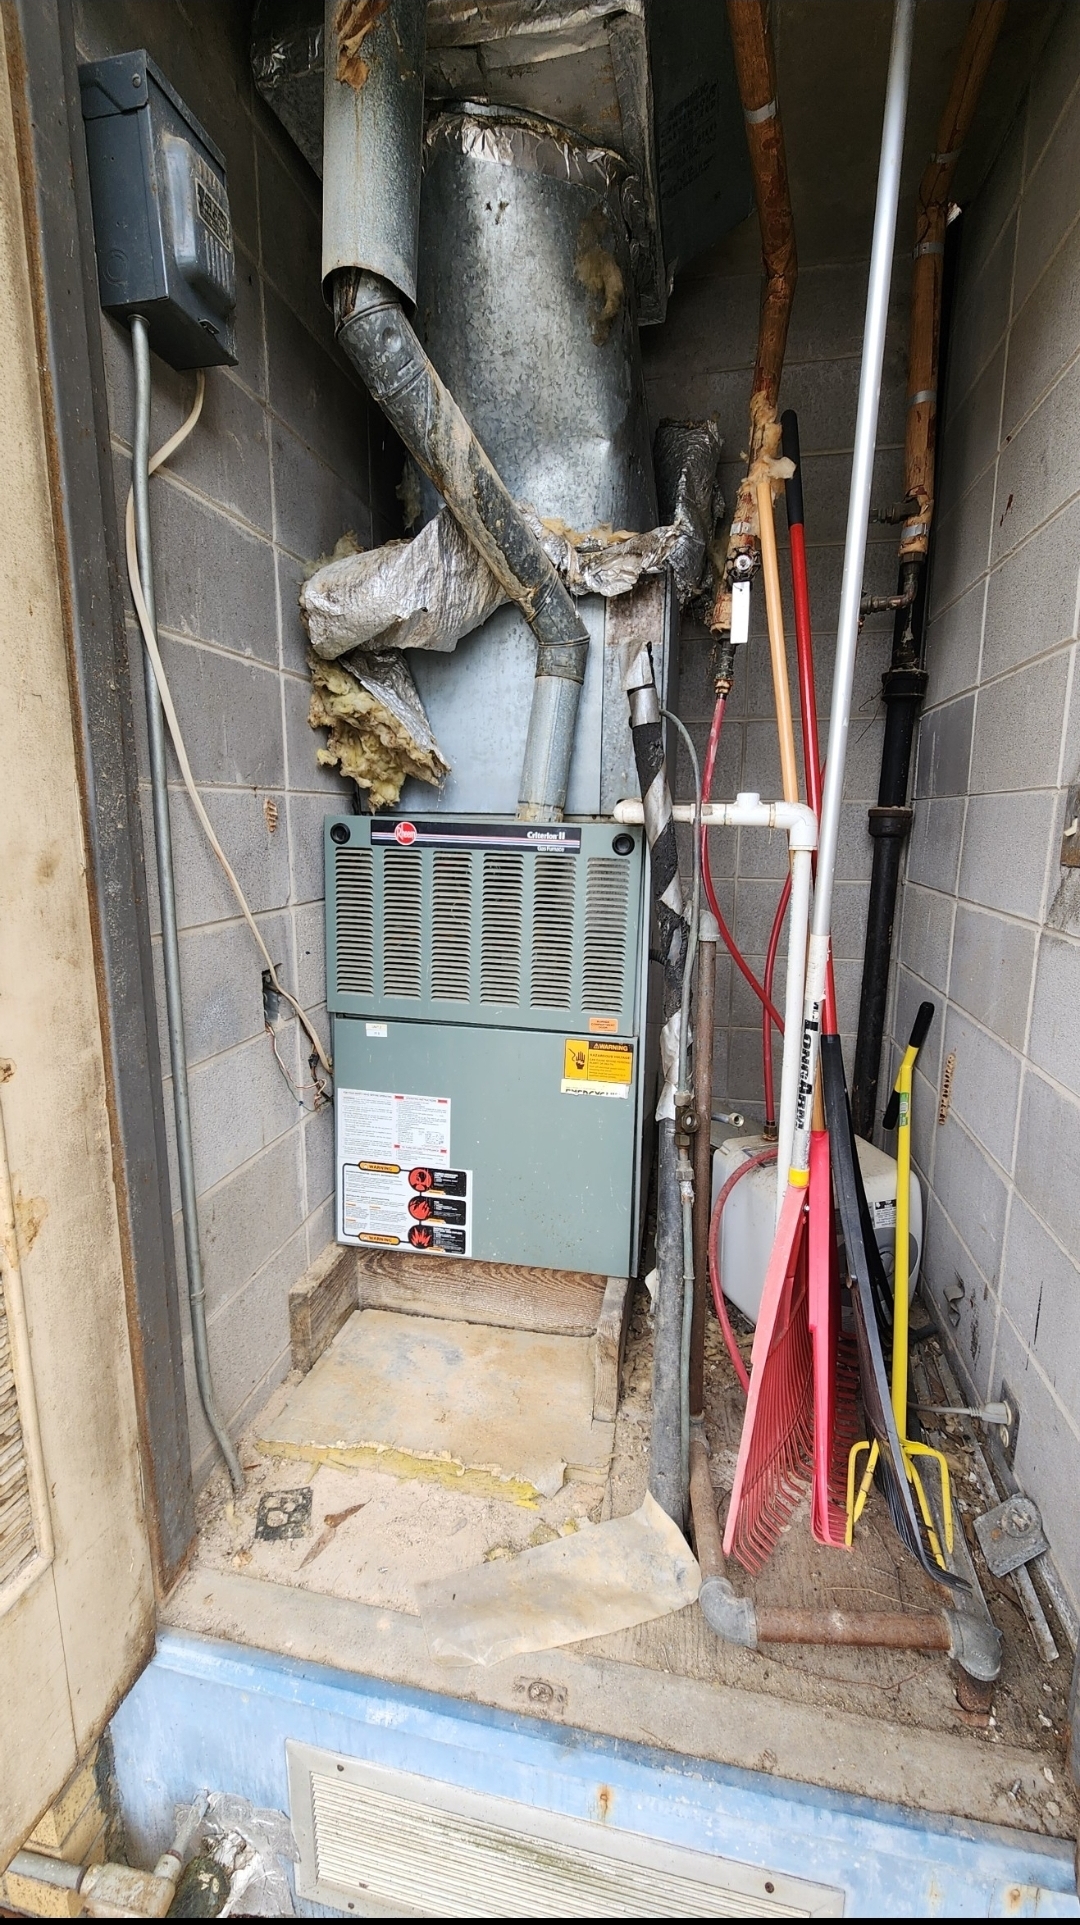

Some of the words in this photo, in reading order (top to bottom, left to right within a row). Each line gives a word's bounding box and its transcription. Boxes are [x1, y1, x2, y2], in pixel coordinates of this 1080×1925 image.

[527, 831, 558, 839] Criterion
[599, 1043, 628, 1051] WARNING
[368, 1235, 392, 1243] WARNING
